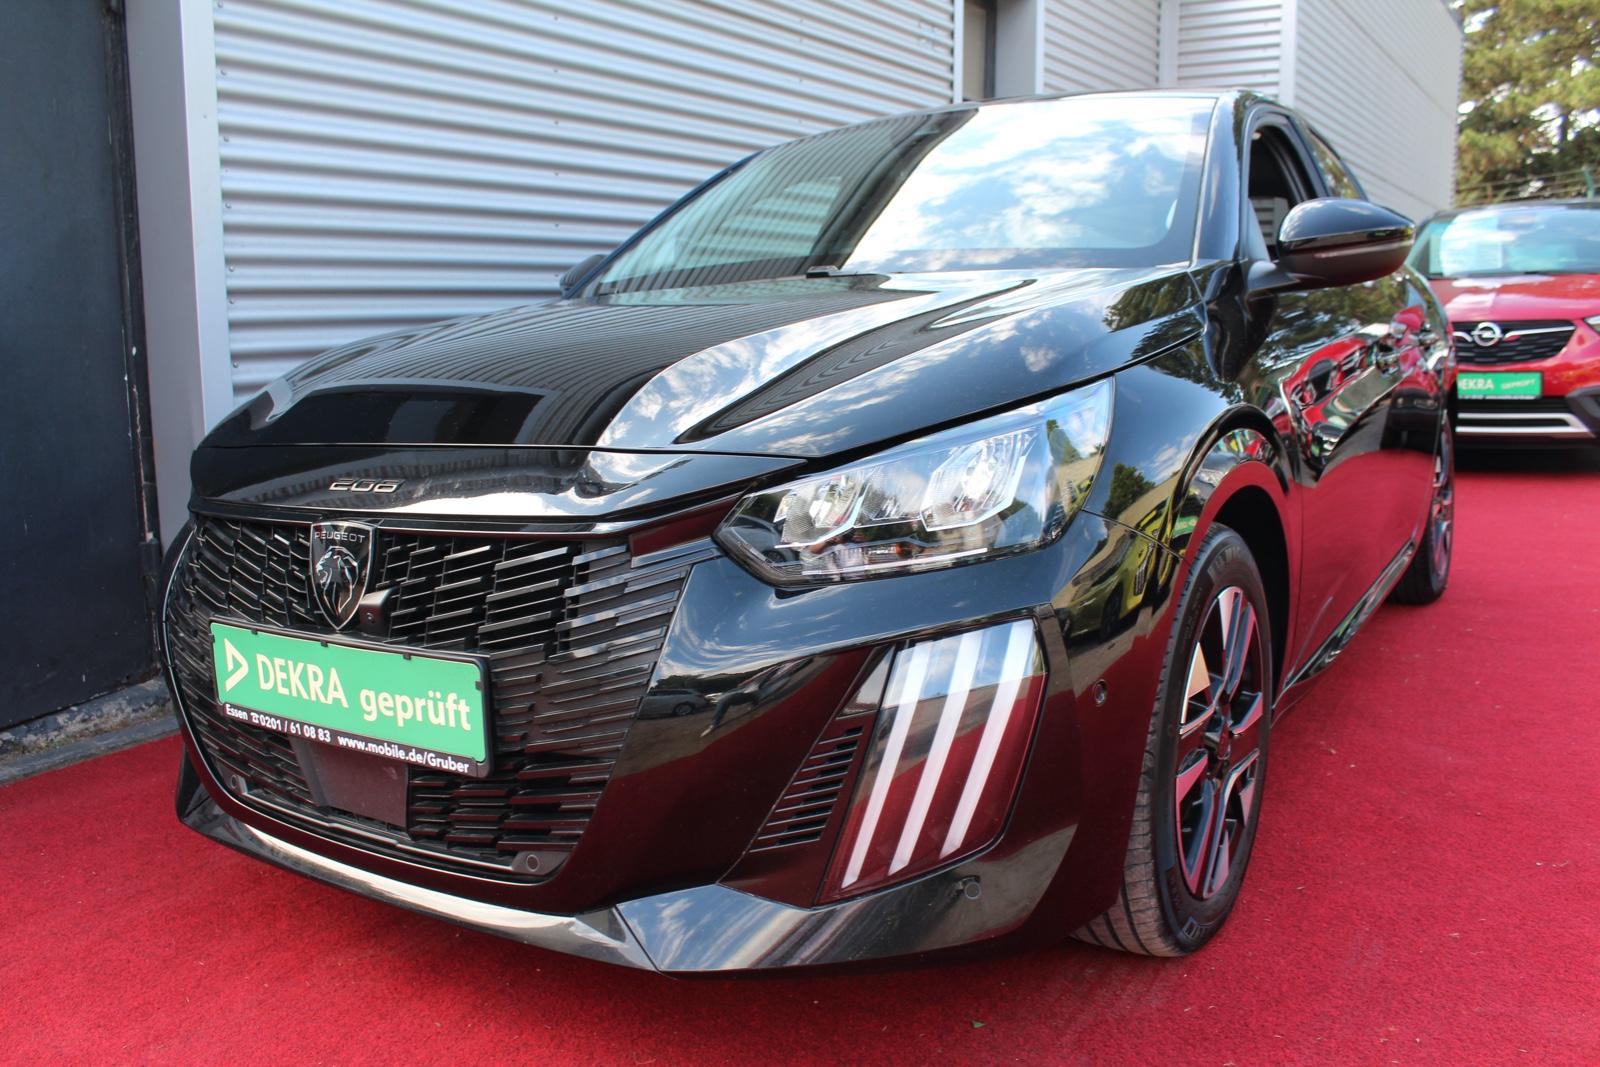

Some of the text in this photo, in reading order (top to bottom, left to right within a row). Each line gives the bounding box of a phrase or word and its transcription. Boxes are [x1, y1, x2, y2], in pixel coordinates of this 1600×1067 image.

[328, 478, 404, 493] 208
[314, 531, 366, 543] PEUGEOT
[256, 653, 471, 731] DEKRA geprüft
[225, 703, 249, 721] Essen
[259, 714, 282, 731] 0201
[289, 722, 301, 736] 61
[303, 725, 317, 739] 08
[317, 728, 331, 743] 83
[337, 735, 470, 773] www.mobile.de/Gruber
